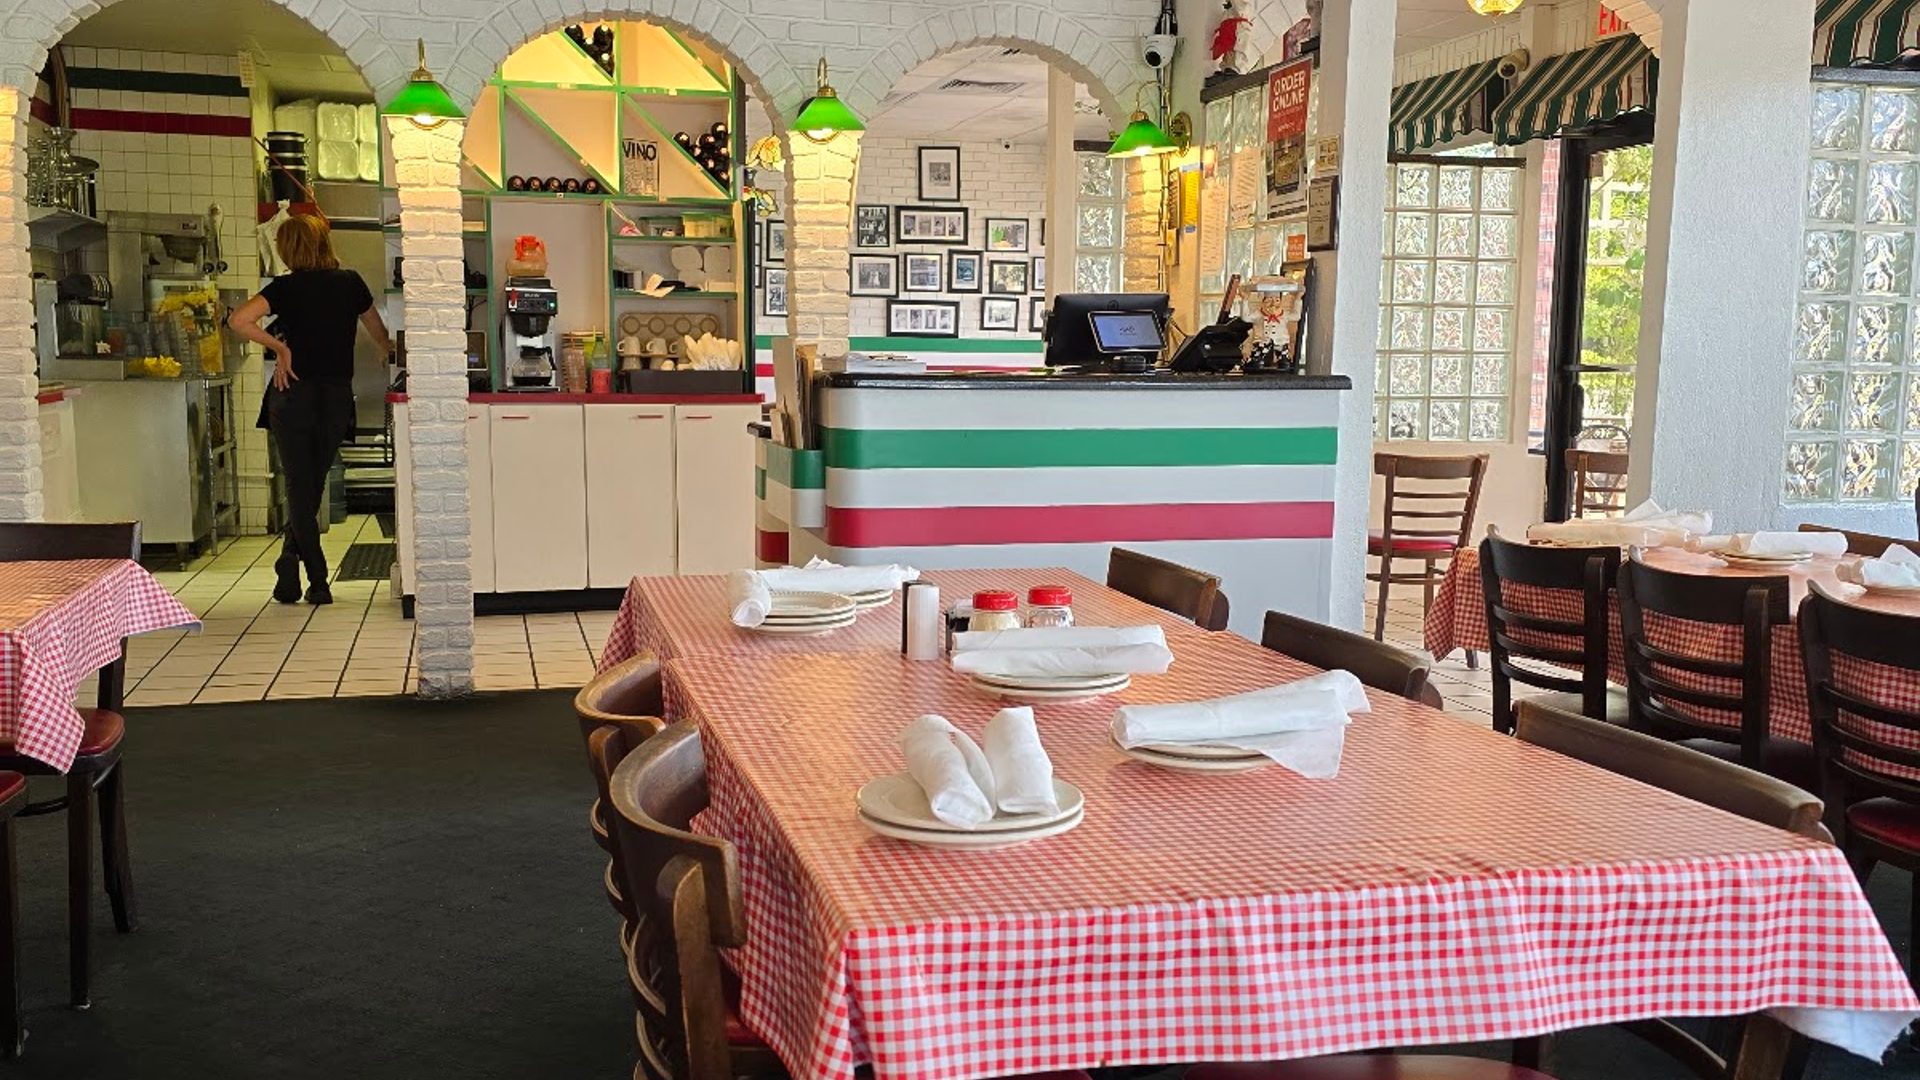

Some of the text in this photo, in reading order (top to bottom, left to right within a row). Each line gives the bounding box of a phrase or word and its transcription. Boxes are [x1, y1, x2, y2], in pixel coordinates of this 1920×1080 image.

[1273, 70, 1305, 96] ORDER
[1273, 87, 1305, 112] ONLINE
[622, 141, 657, 161] VINO
